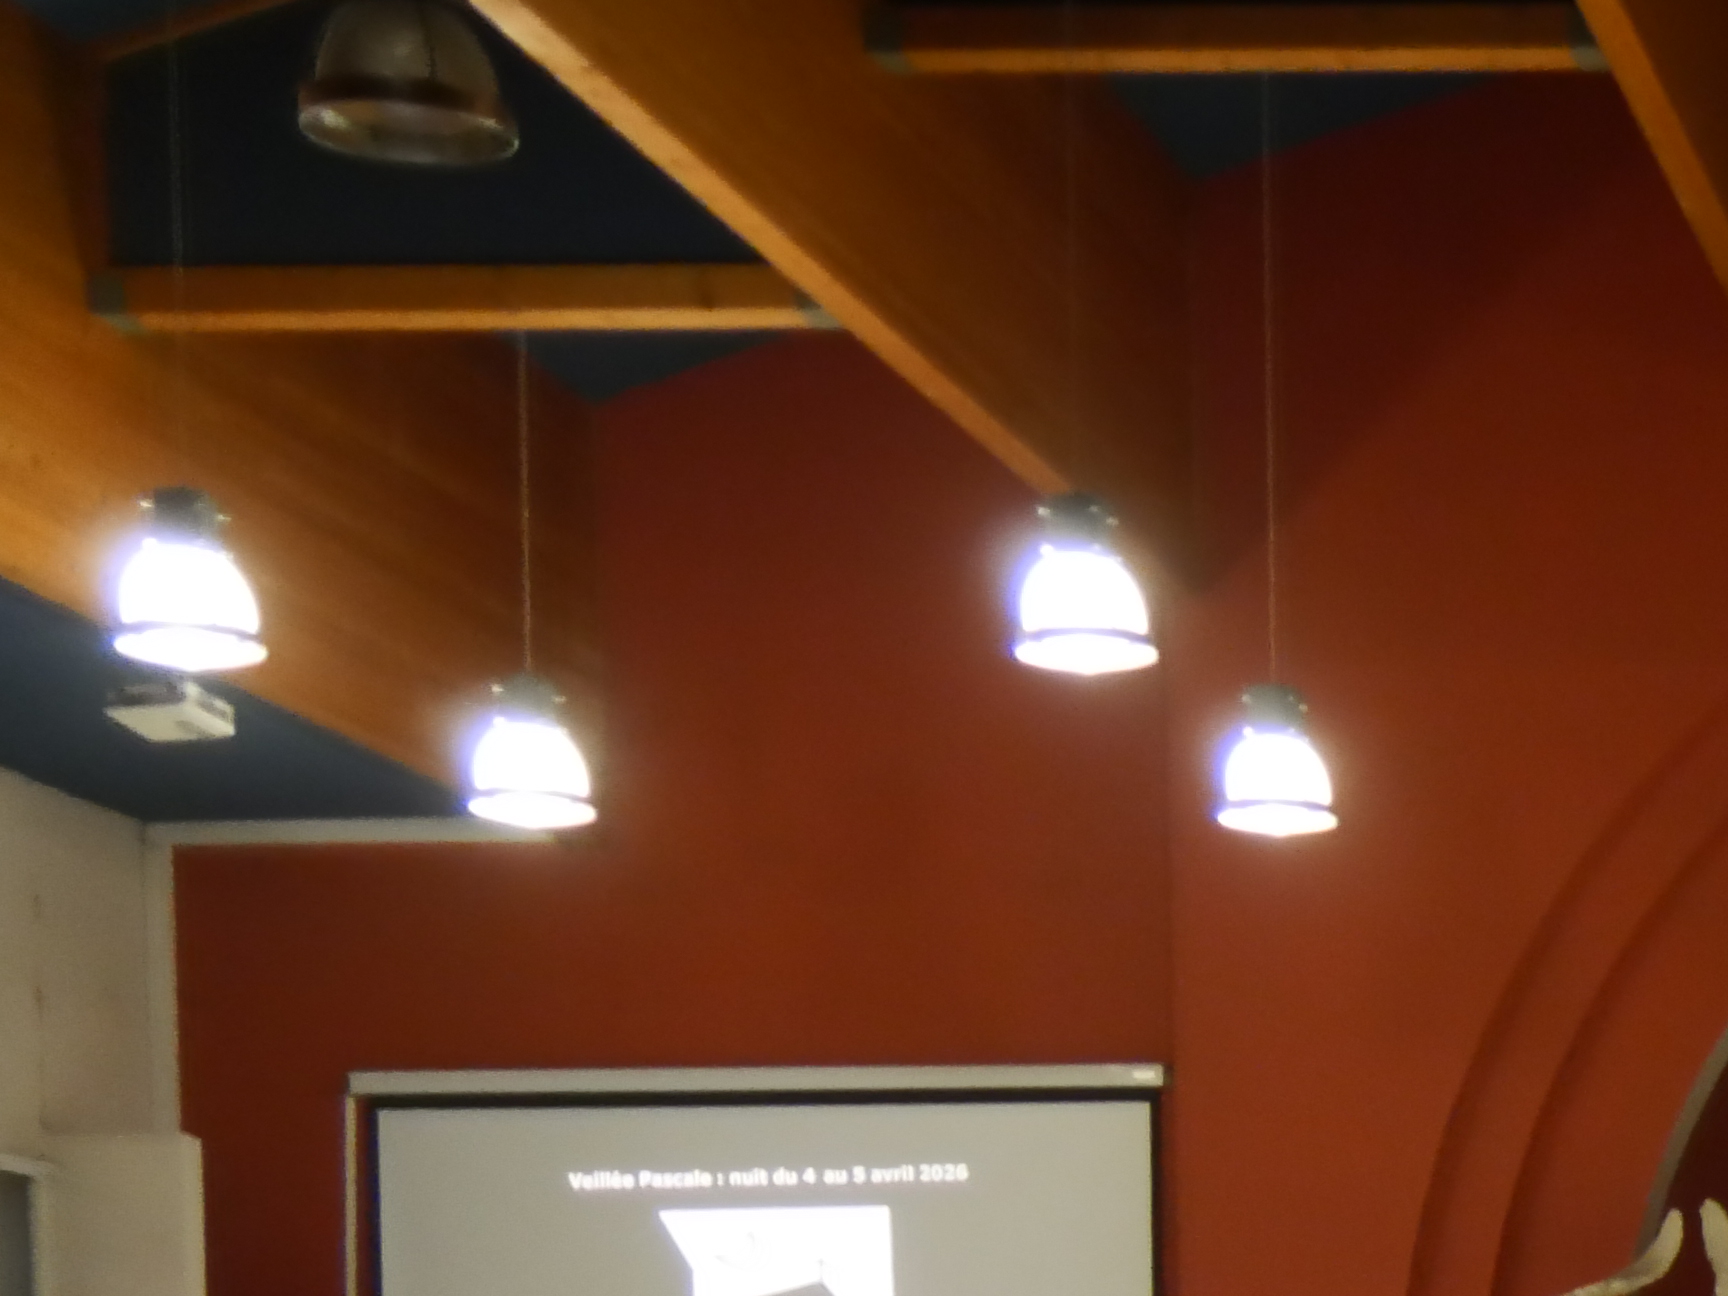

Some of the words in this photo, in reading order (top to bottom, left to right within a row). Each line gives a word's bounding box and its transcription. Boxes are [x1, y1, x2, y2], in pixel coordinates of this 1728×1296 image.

[568, 1169, 636, 1191] Veillée
[638, 1169, 714, 1189] Pascale
[728, 1167, 769, 1187] nuit
[771, 1166, 799, 1186] du
[801, 1166, 818, 1185] 4
[822, 1169, 849, 1185] au
[852, 1165, 867, 1185] 5
[869, 1164, 915, 1184] avril
[919, 1163, 969, 1182] 2026
